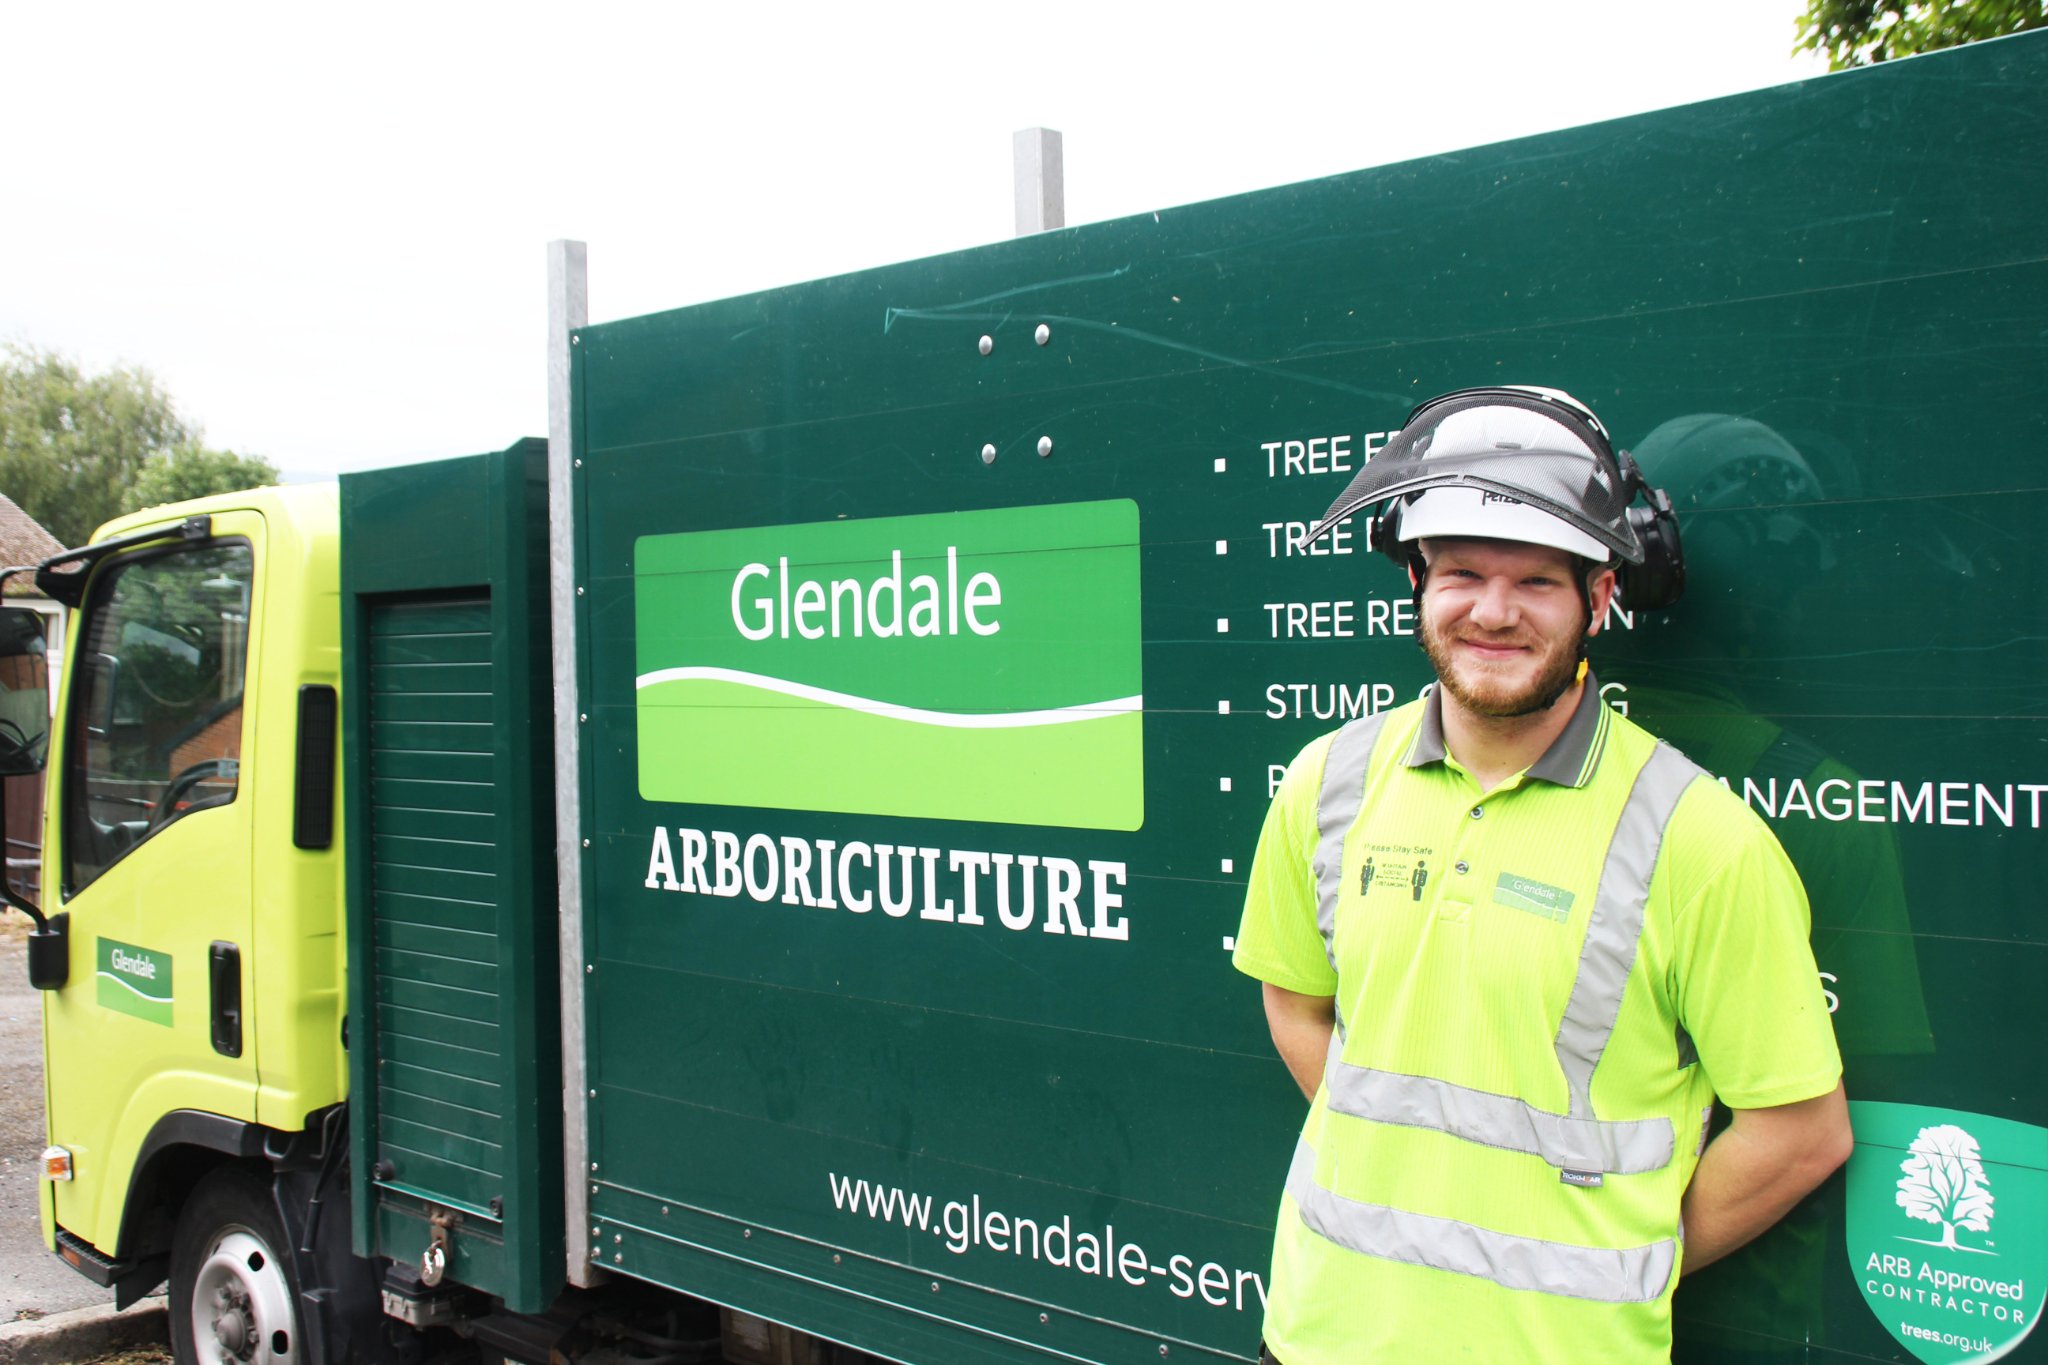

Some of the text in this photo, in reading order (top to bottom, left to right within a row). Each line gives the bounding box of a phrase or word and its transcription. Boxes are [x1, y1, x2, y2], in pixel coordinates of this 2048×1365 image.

[1261, 435, 1351, 477] TREE
[1262, 518, 1352, 558] TREE
[731, 546, 1002, 641] Glendale
[1264, 601, 1354, 638] TREE
[1266, 683, 1395, 719] STUMP
[644, 825, 1129, 941] ARBORICULTURE
[112, 948, 156, 979] Glendale
[1866, 1252, 2023, 1301] ARB Approved
[1866, 1280, 2024, 1324] CONTRACTOR
[1901, 1321, 1993, 1354] trees.org.uk
